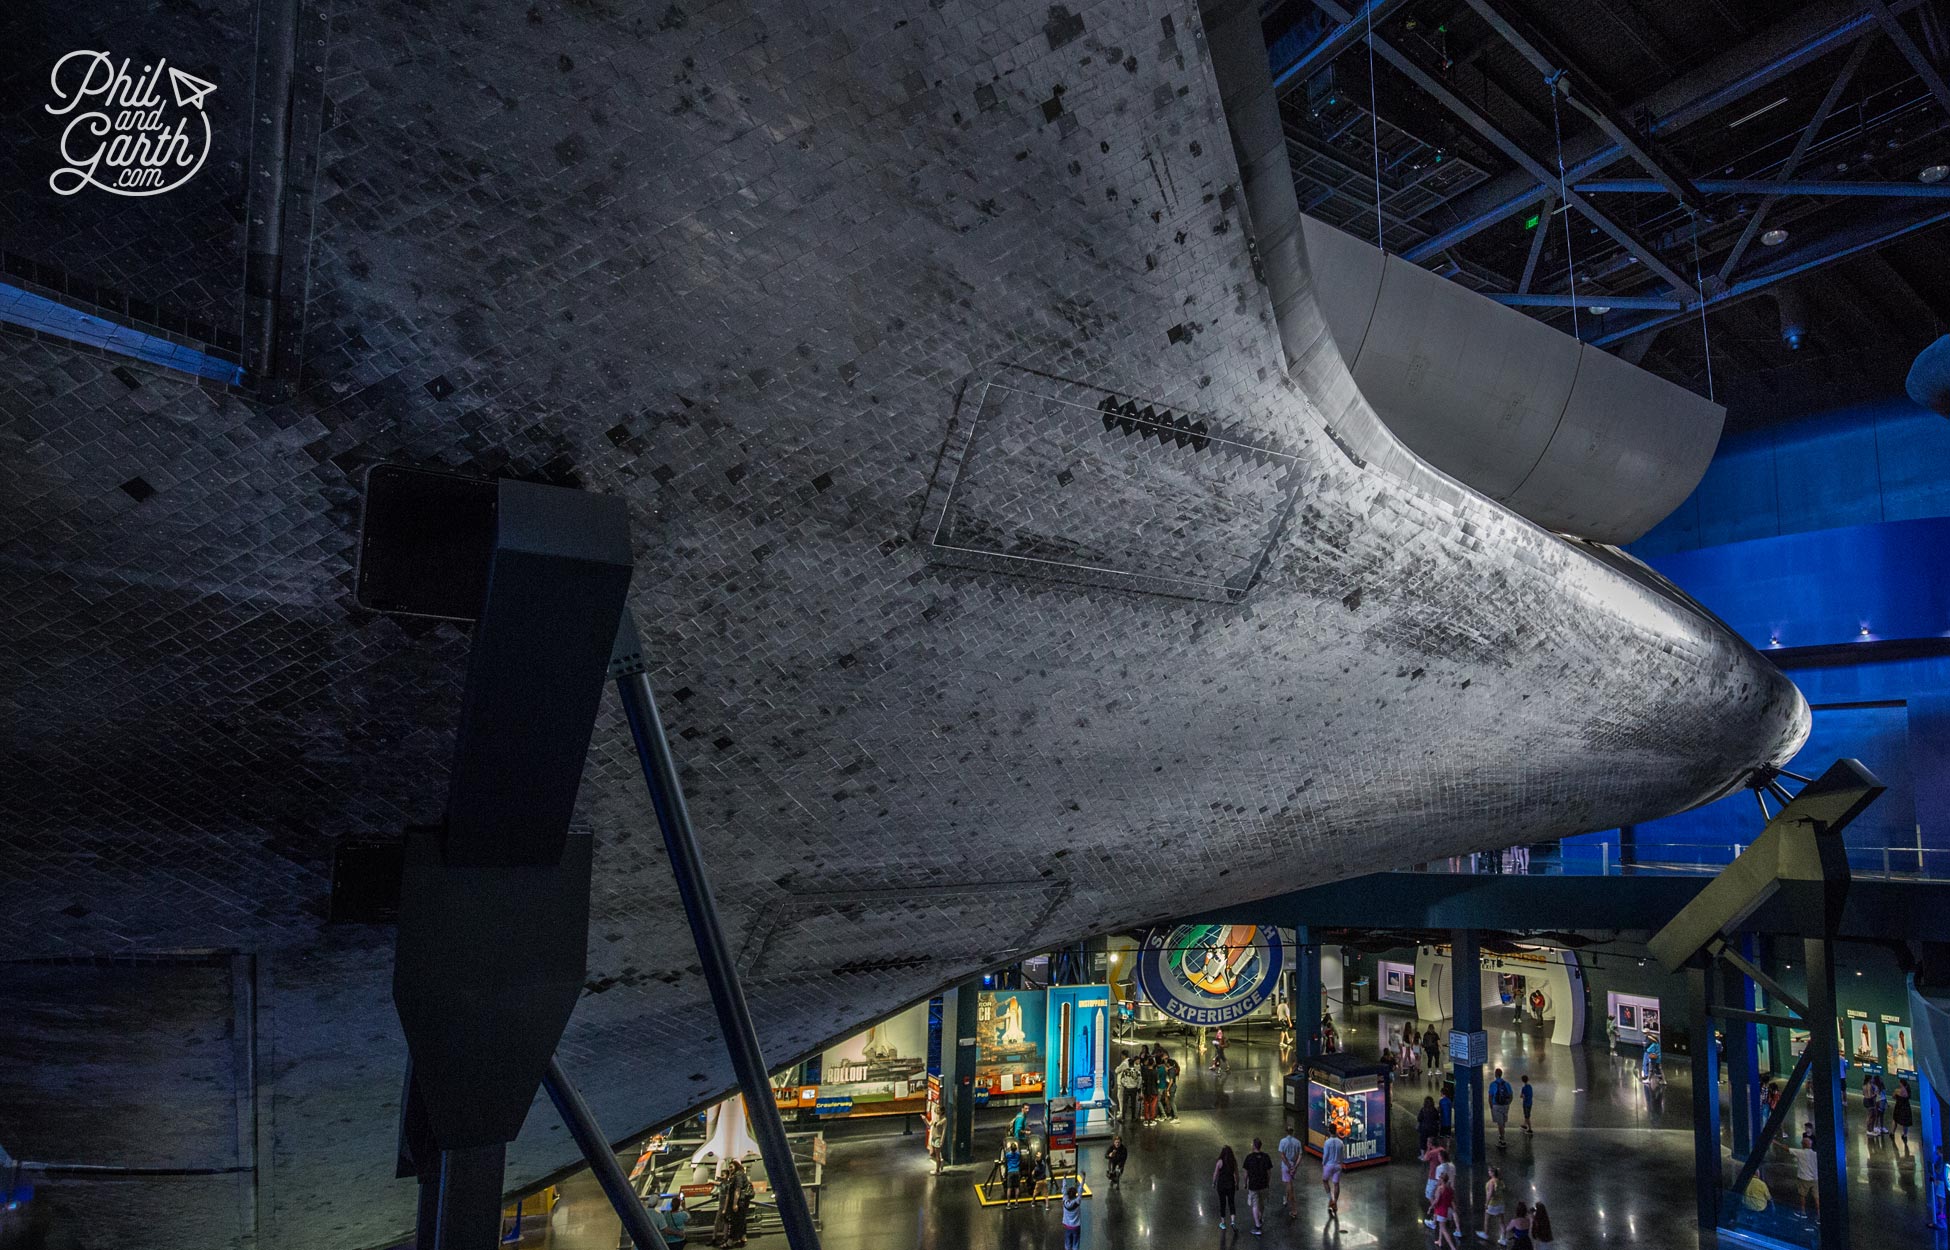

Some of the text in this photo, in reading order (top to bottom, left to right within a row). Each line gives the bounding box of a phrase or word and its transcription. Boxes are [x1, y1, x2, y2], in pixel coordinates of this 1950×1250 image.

[1166, 990, 1263, 1023] EXPERIENCE
[827, 1066, 868, 1083] ROLLOUT
[816, 1101, 853, 1109] Crawlerway
[1346, 1139, 1377, 1159] LAUNCH
